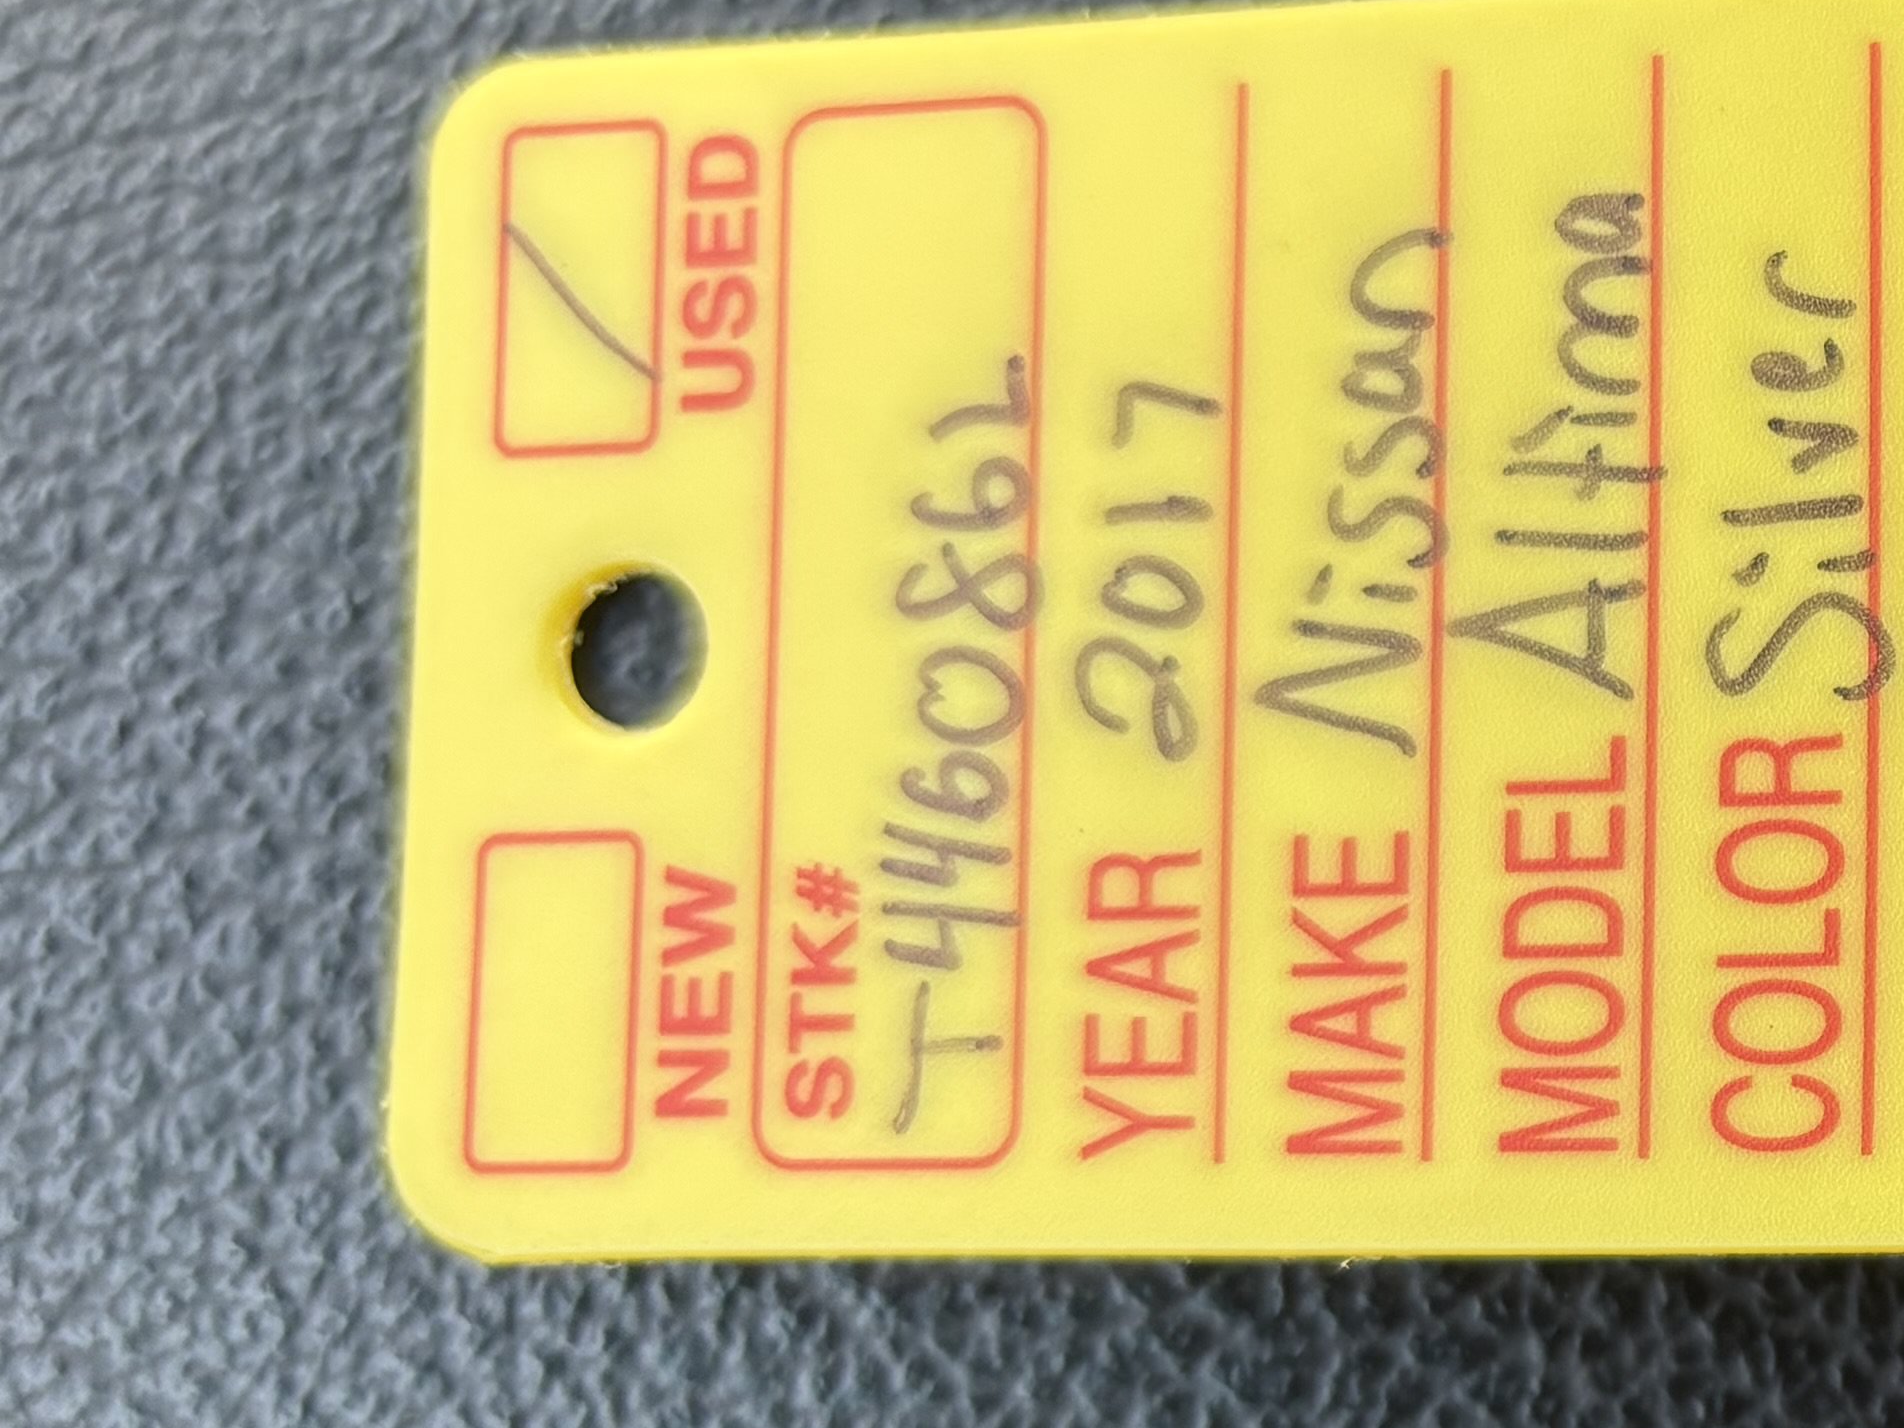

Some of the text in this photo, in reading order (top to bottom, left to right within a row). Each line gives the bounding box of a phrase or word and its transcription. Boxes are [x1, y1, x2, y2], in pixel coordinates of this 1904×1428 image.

[676, 132, 765, 414] USED
[654, 866, 738, 1122] NEW
[783, 862, 864, 1122] STK#
[1072, 378, 1222, 1164] YEAR 2017
[1254, 227, 1454, 1157] MAKE Nissan
[1450, 192, 1667, 1155] MODEL Altima
[1706, 251, 1896, 1155] COLOR Silver
